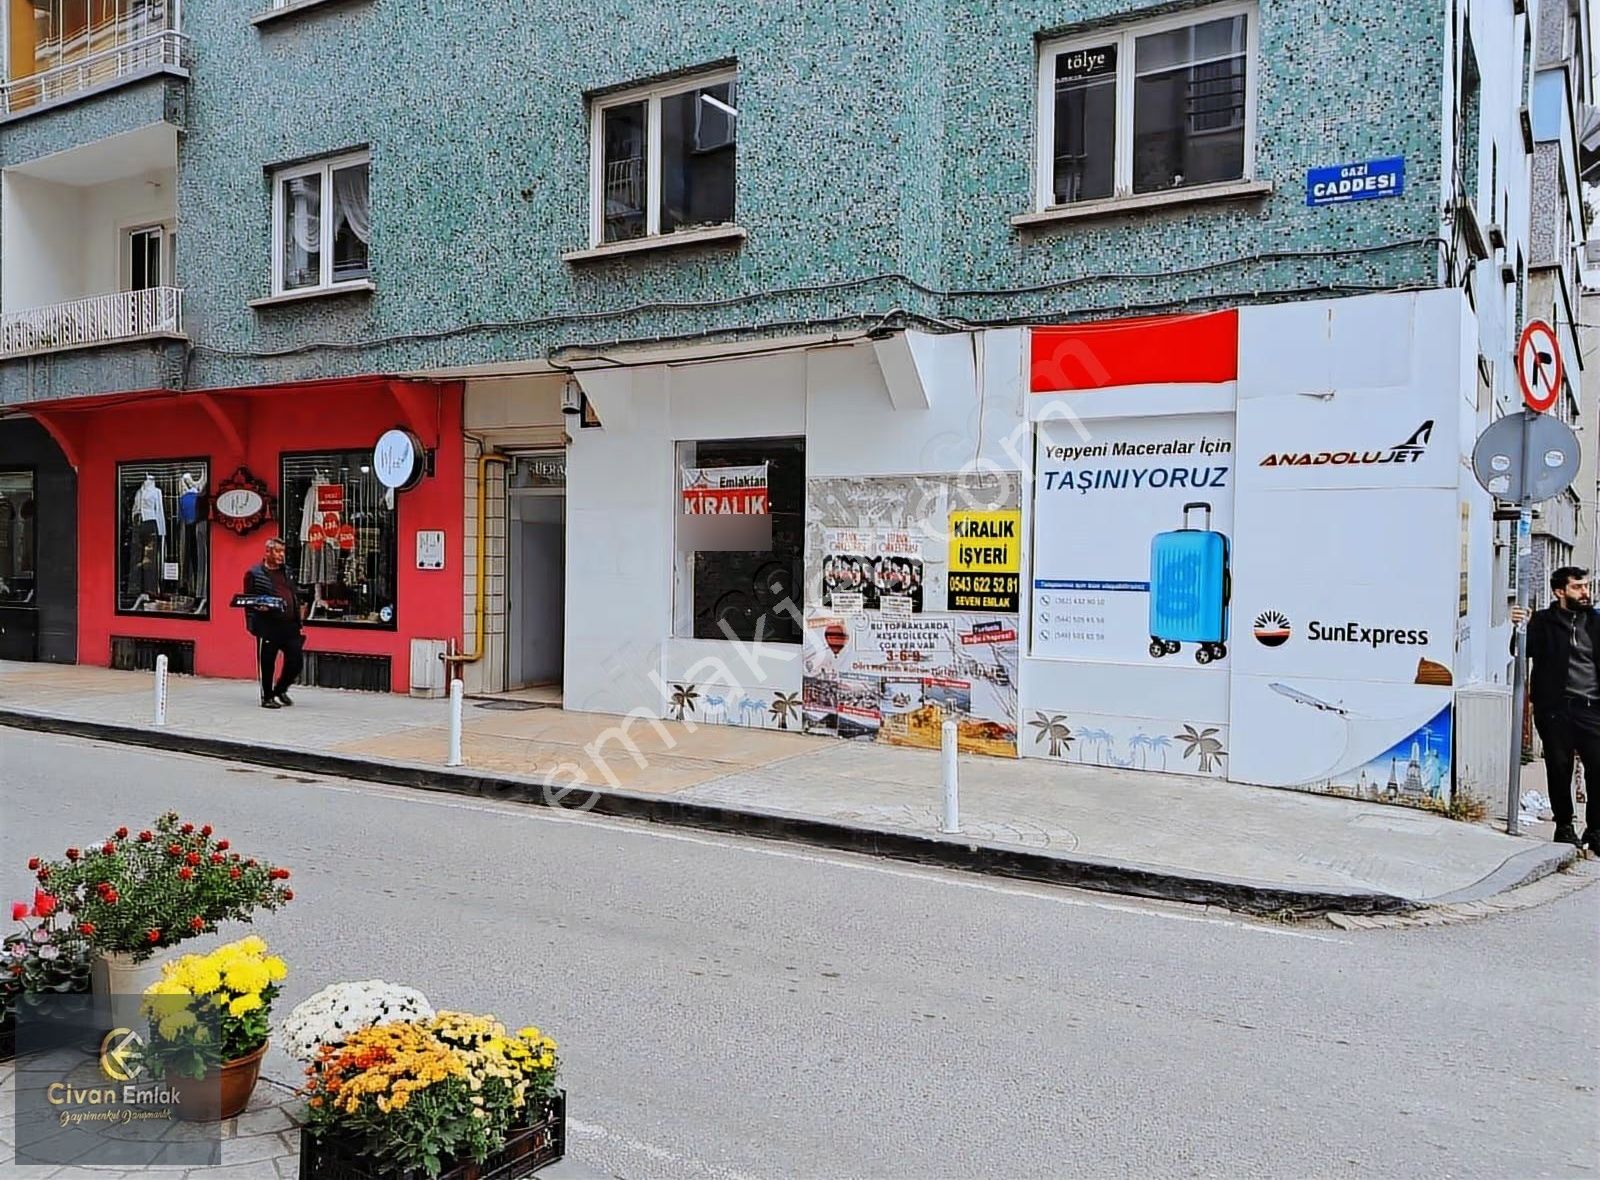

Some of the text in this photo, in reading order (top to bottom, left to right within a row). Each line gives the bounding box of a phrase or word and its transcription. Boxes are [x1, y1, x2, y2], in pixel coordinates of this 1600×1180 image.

[1067, 51, 1105, 72] tölye
[1045, 436, 1232, 462] Yepyeni Maceralar İçin
[1259, 450, 1425, 467] ANADOLUJET
[1044, 467, 1229, 495] TAŞINIYORUZ
[684, 492, 765, 515] KİRALIK
[954, 516, 1014, 538] KİRALIK
[959, 543, 1007, 568] İŞYERİ
[949, 576, 971, 592] 0543
[974, 577, 990, 592] 622
[993, 577, 1005, 592] 52
[955, 596, 1010, 608] SEVEN EMLAK
[1308, 621, 1428, 648] SunExpress
[886, 650, 921, 662] 3-6-9
